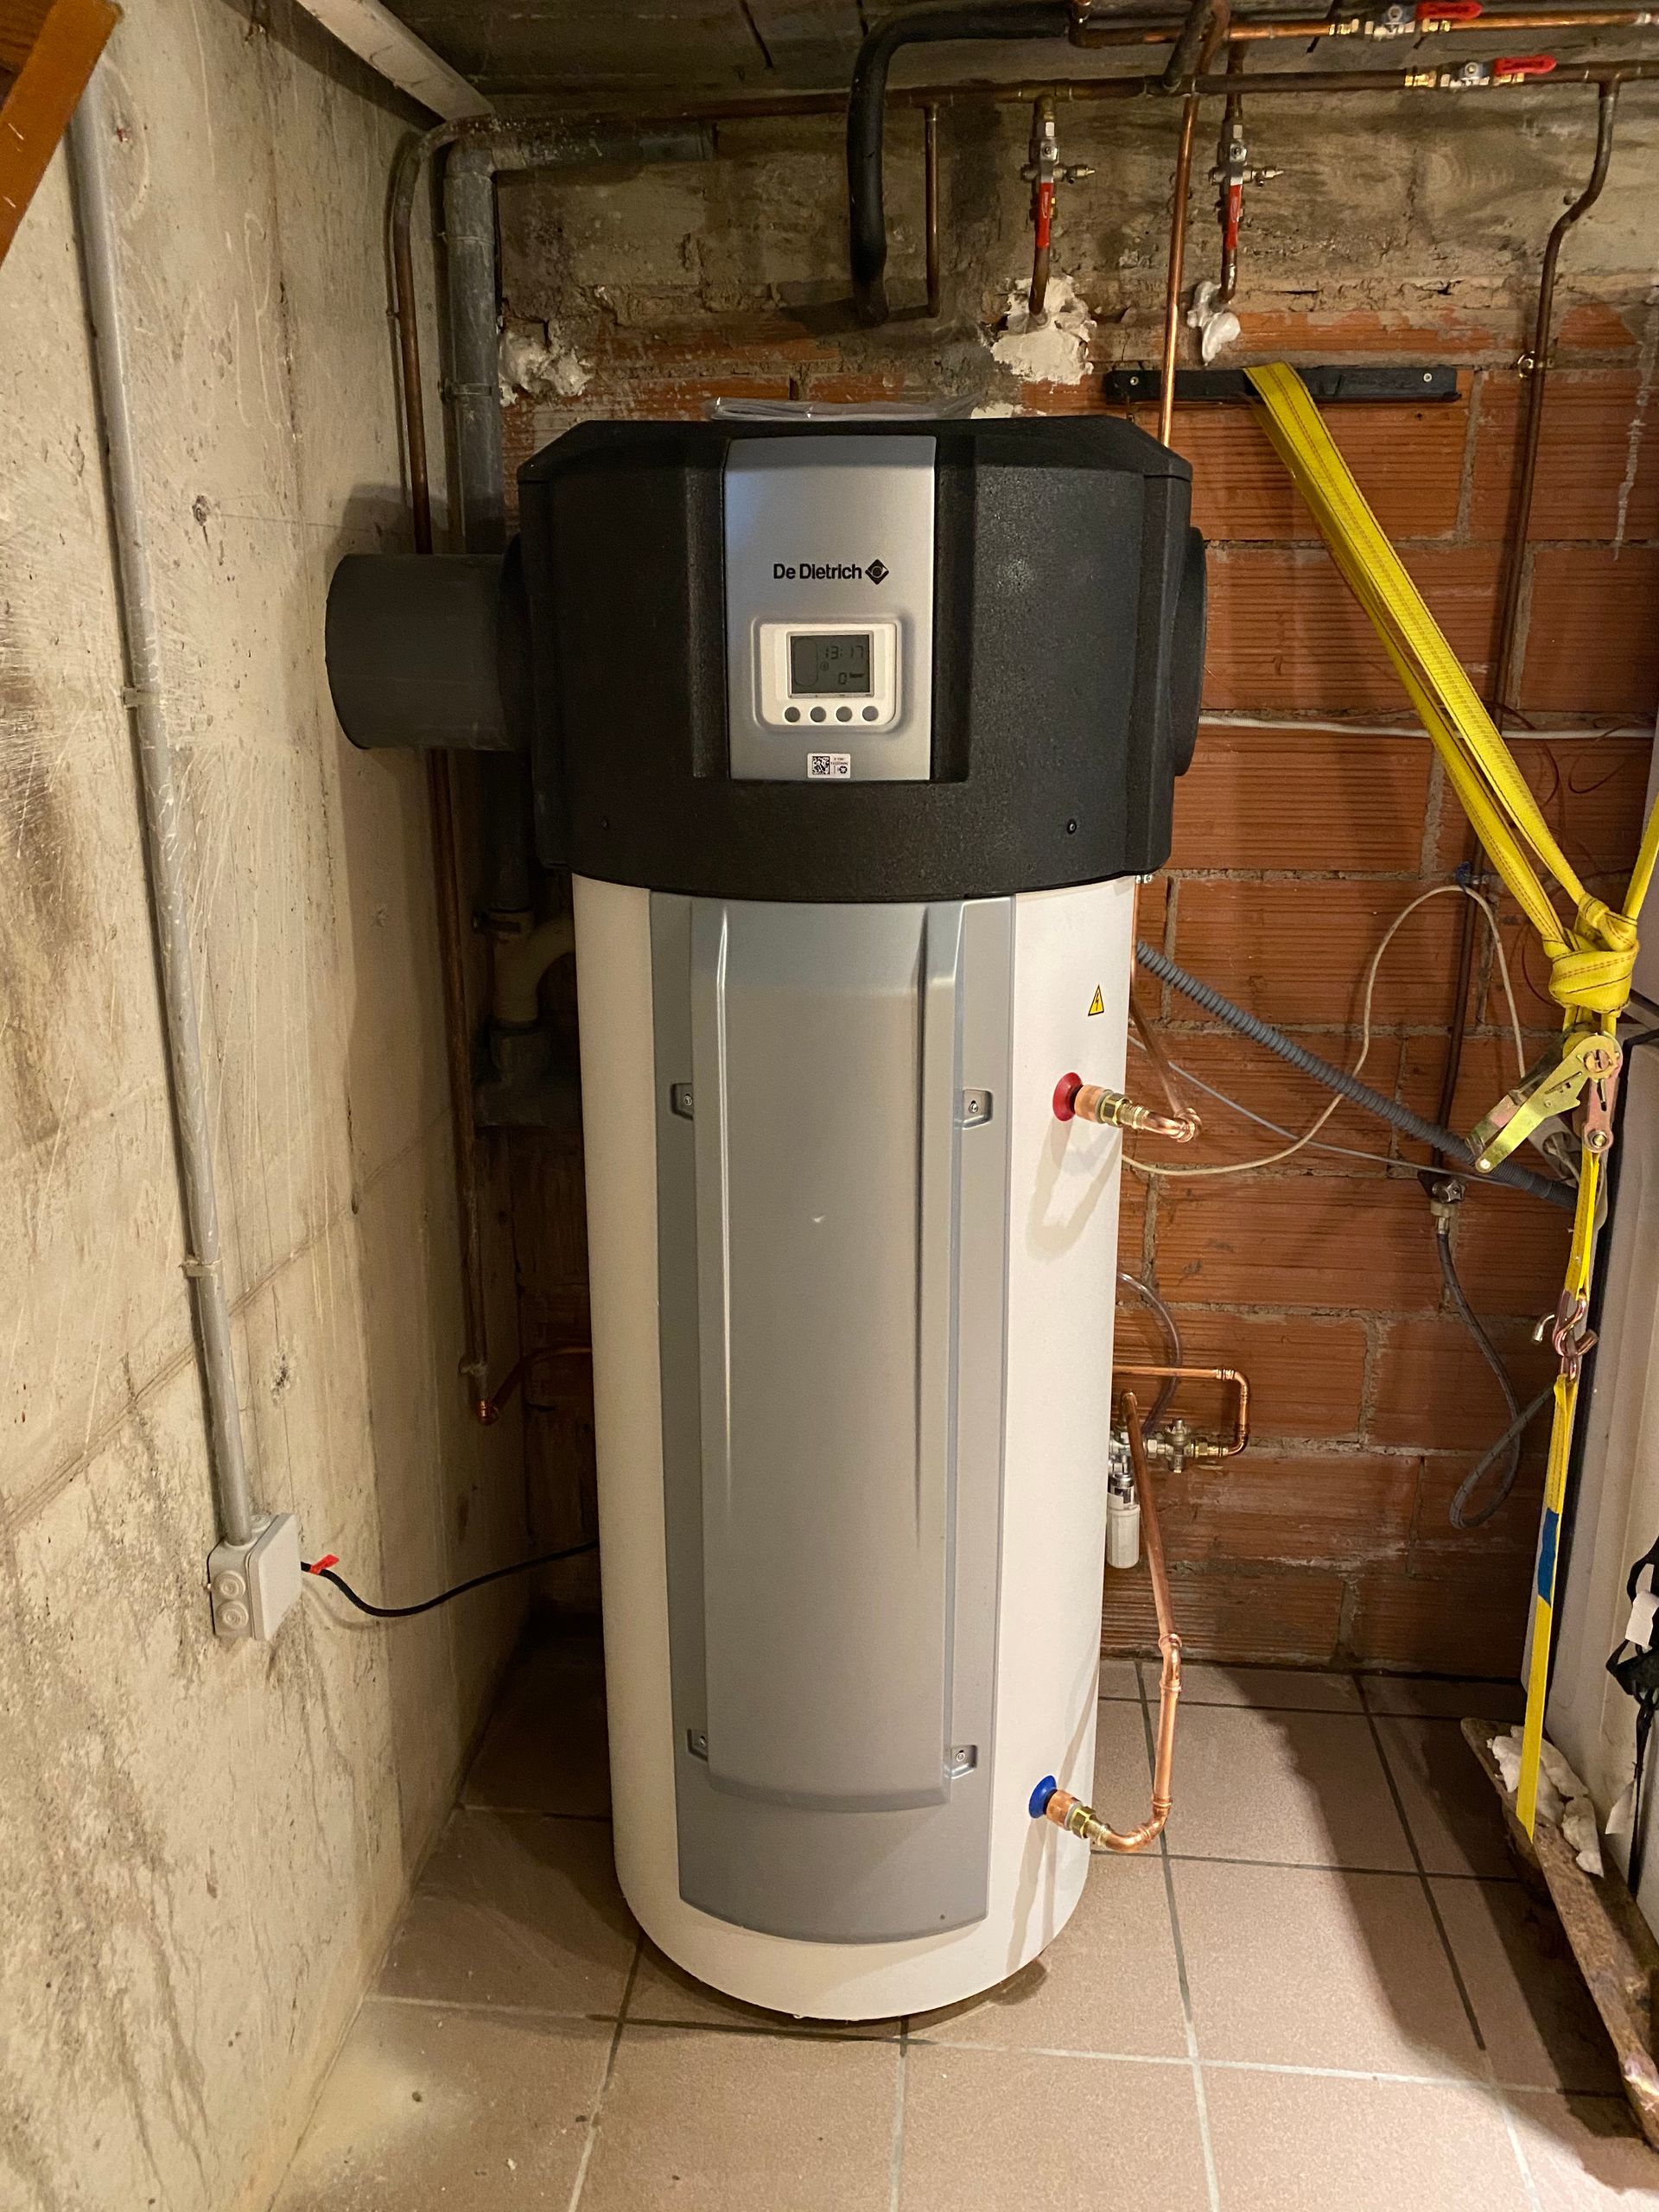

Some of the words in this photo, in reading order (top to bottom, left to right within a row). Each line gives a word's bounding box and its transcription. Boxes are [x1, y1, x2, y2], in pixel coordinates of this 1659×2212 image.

[773, 563, 796, 579] De
[799, 563, 862, 579] Dietrich
[825, 645, 865, 660] 13:17
